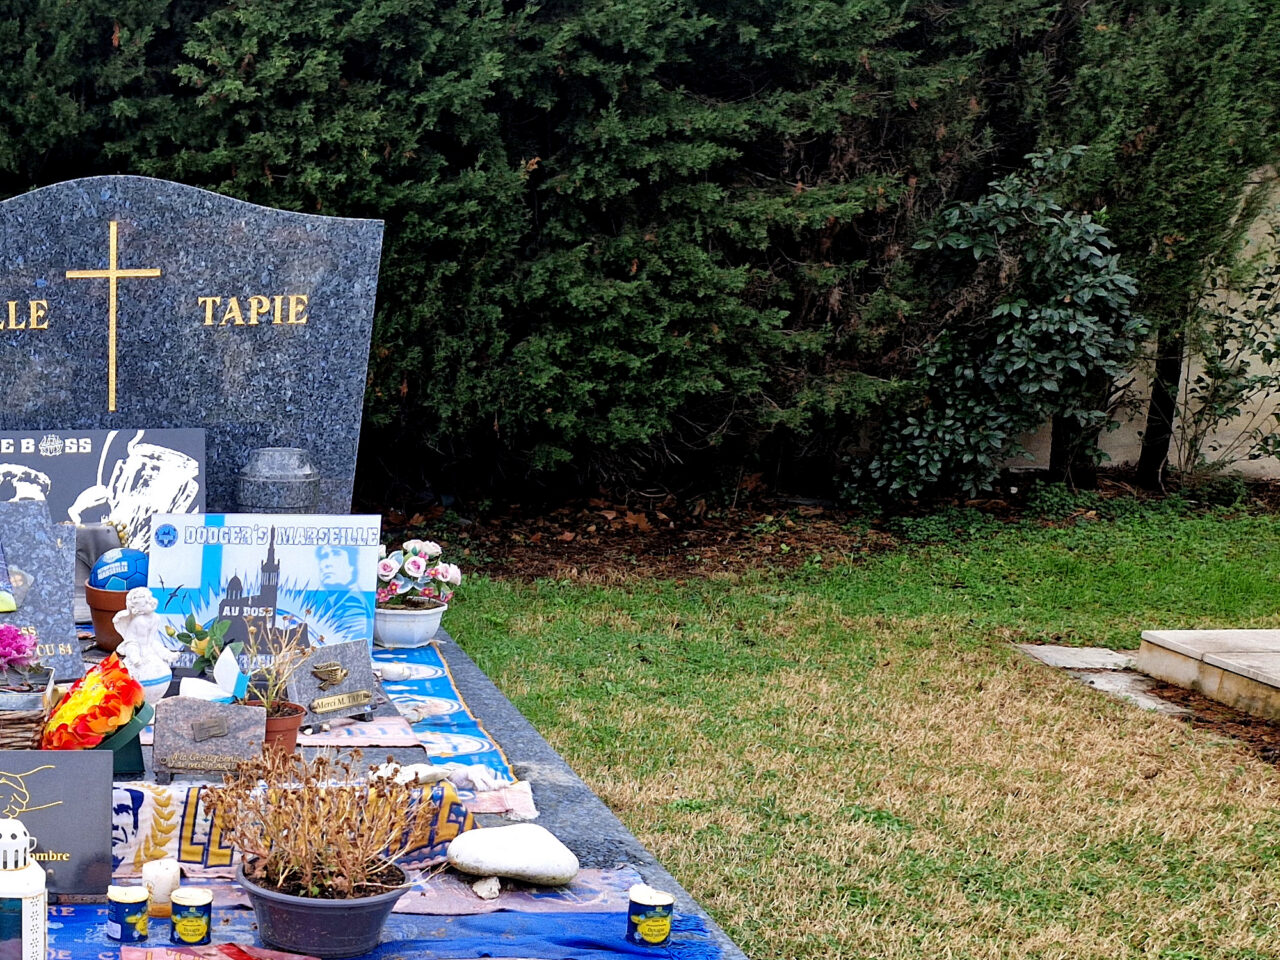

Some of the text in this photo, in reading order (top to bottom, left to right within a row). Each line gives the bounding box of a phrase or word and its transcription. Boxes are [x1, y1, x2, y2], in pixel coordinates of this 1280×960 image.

[198, 294, 309, 326] TAPIE
[184, 524, 269, 545] DODGER'S
[276, 527, 379, 546] MARSEILLE
[222, 605, 239, 616] AU
